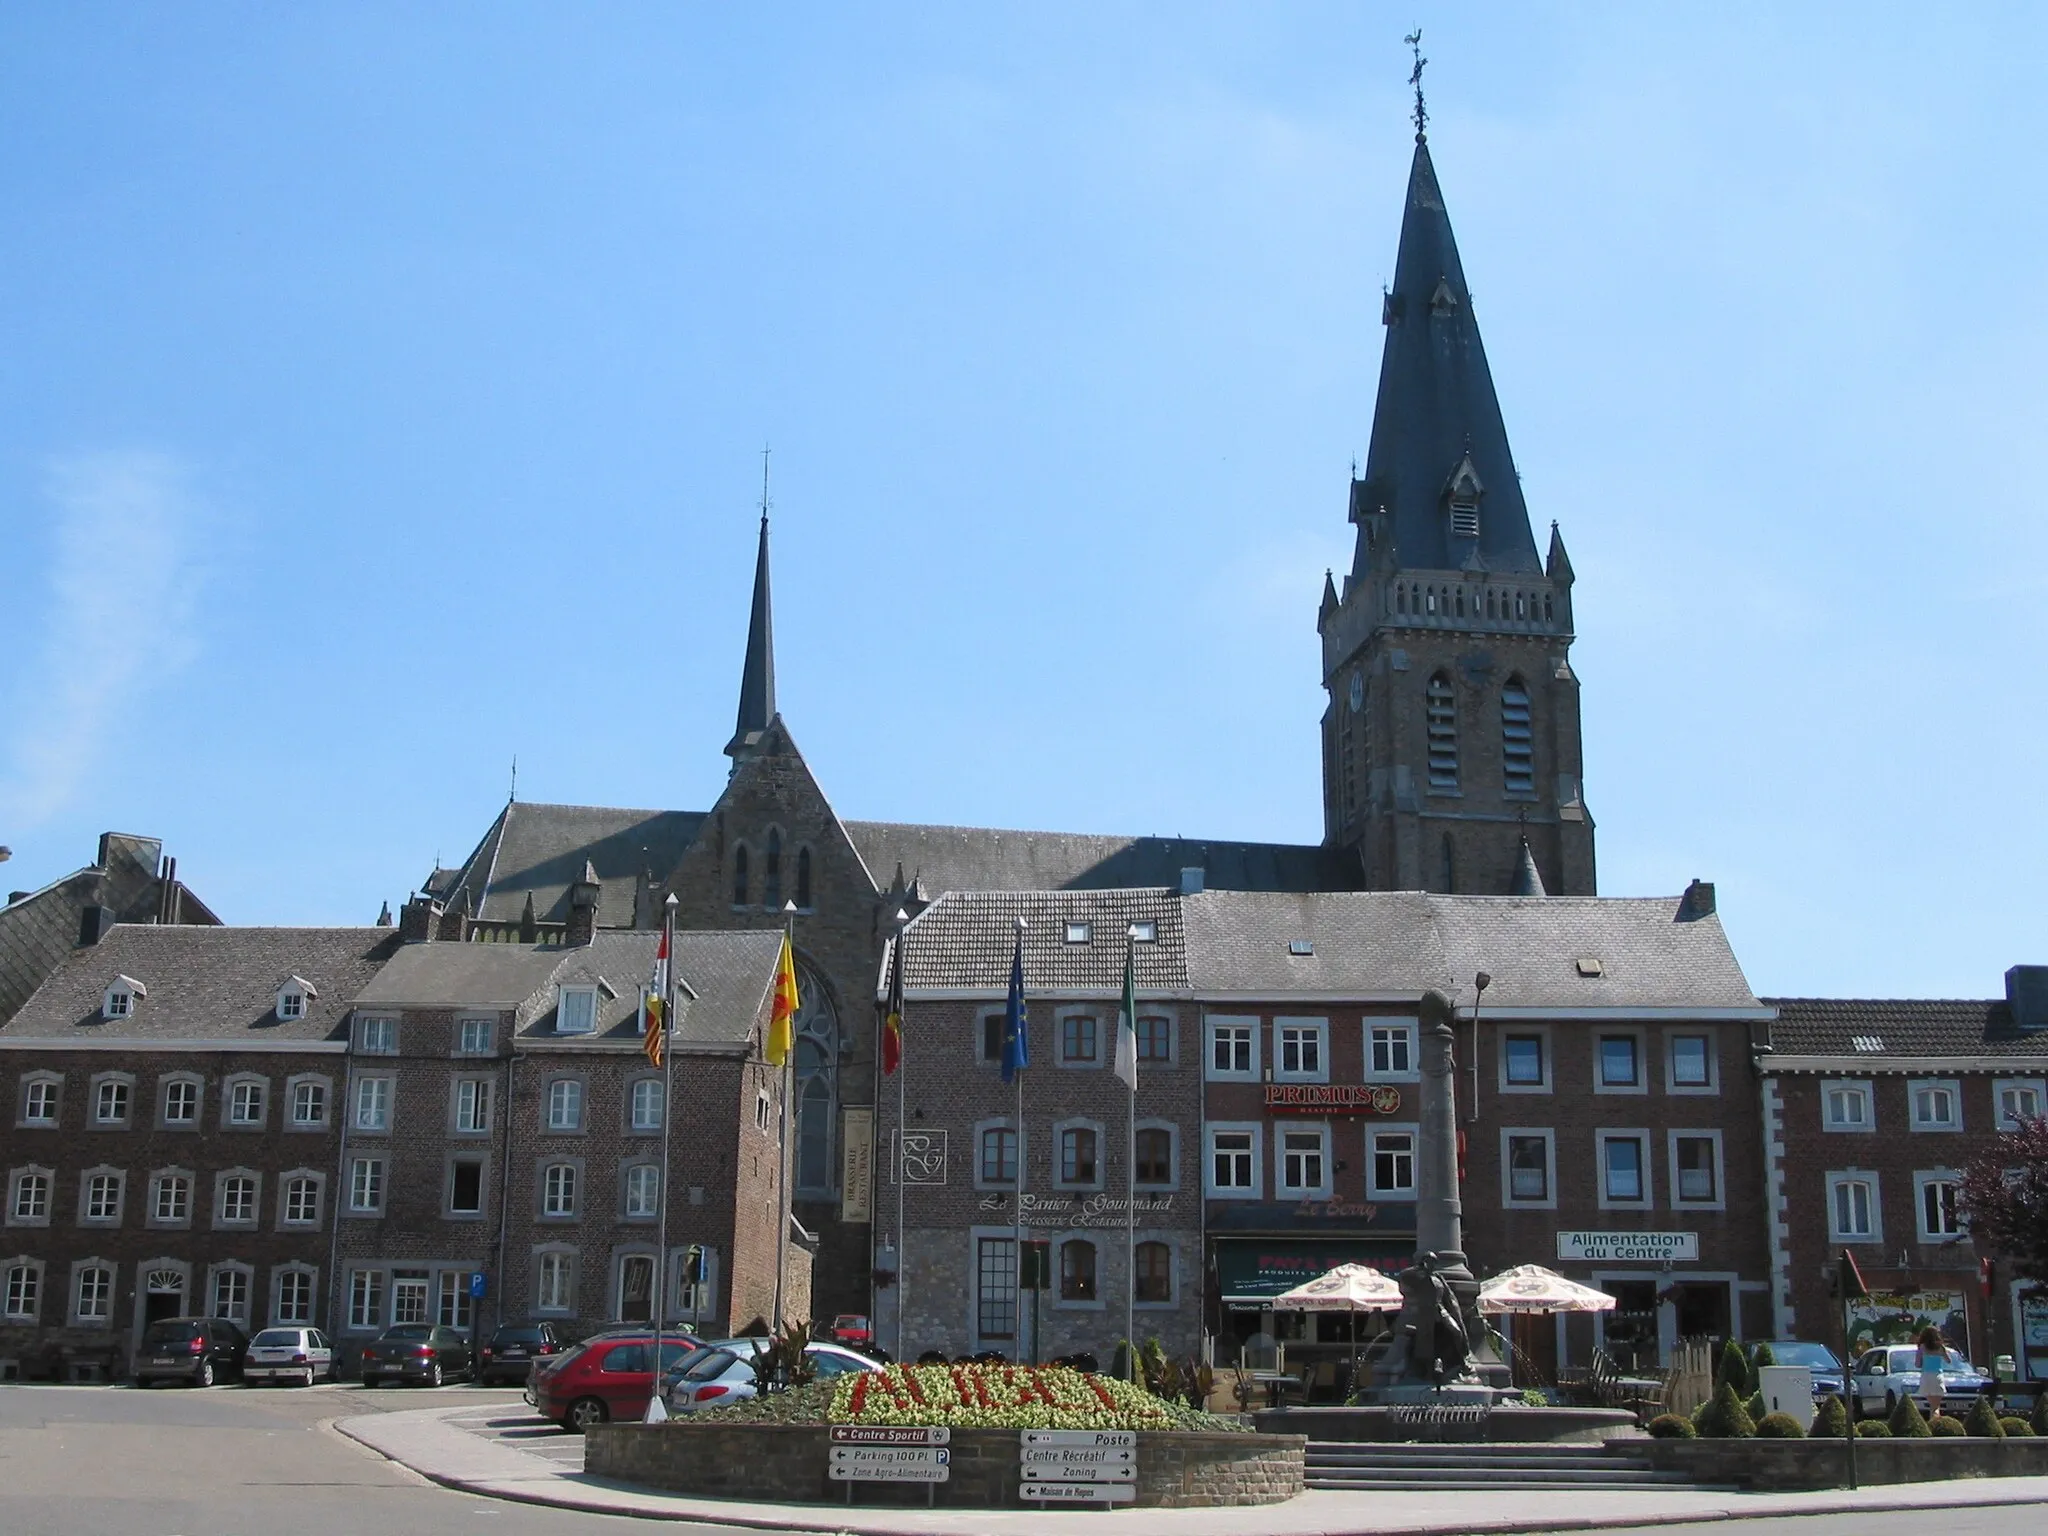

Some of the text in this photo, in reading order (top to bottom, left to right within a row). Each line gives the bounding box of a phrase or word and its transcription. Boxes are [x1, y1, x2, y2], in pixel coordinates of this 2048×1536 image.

[1265, 1085, 1372, 1105] PRIMUS
[848, 1149, 857, 1201] BRASSERIE
[859, 1143, 868, 1208] RESTAURANT
[979, 1193, 1174, 1216] Le Panier Gourmand
[1571, 1233, 1684, 1246] Alimentation
[1584, 1247, 1672, 1259] du Centre
[472, 1274, 482, 1288] P
[850, 1429, 925, 1442] Centre Sportif
[1095, 1434, 1130, 1446] Poste
[854, 1450, 893, 1462] Parking
[896, 1451, 915, 1461] 100
[1026, 1449, 1106, 1461] Centre Récréatif
[853, 1467, 942, 1479] Zone Agro-Alimentaire
[1063, 1467, 1097, 1479] Zoning
[1040, 1487, 1094, 1498] Maison de Repos
